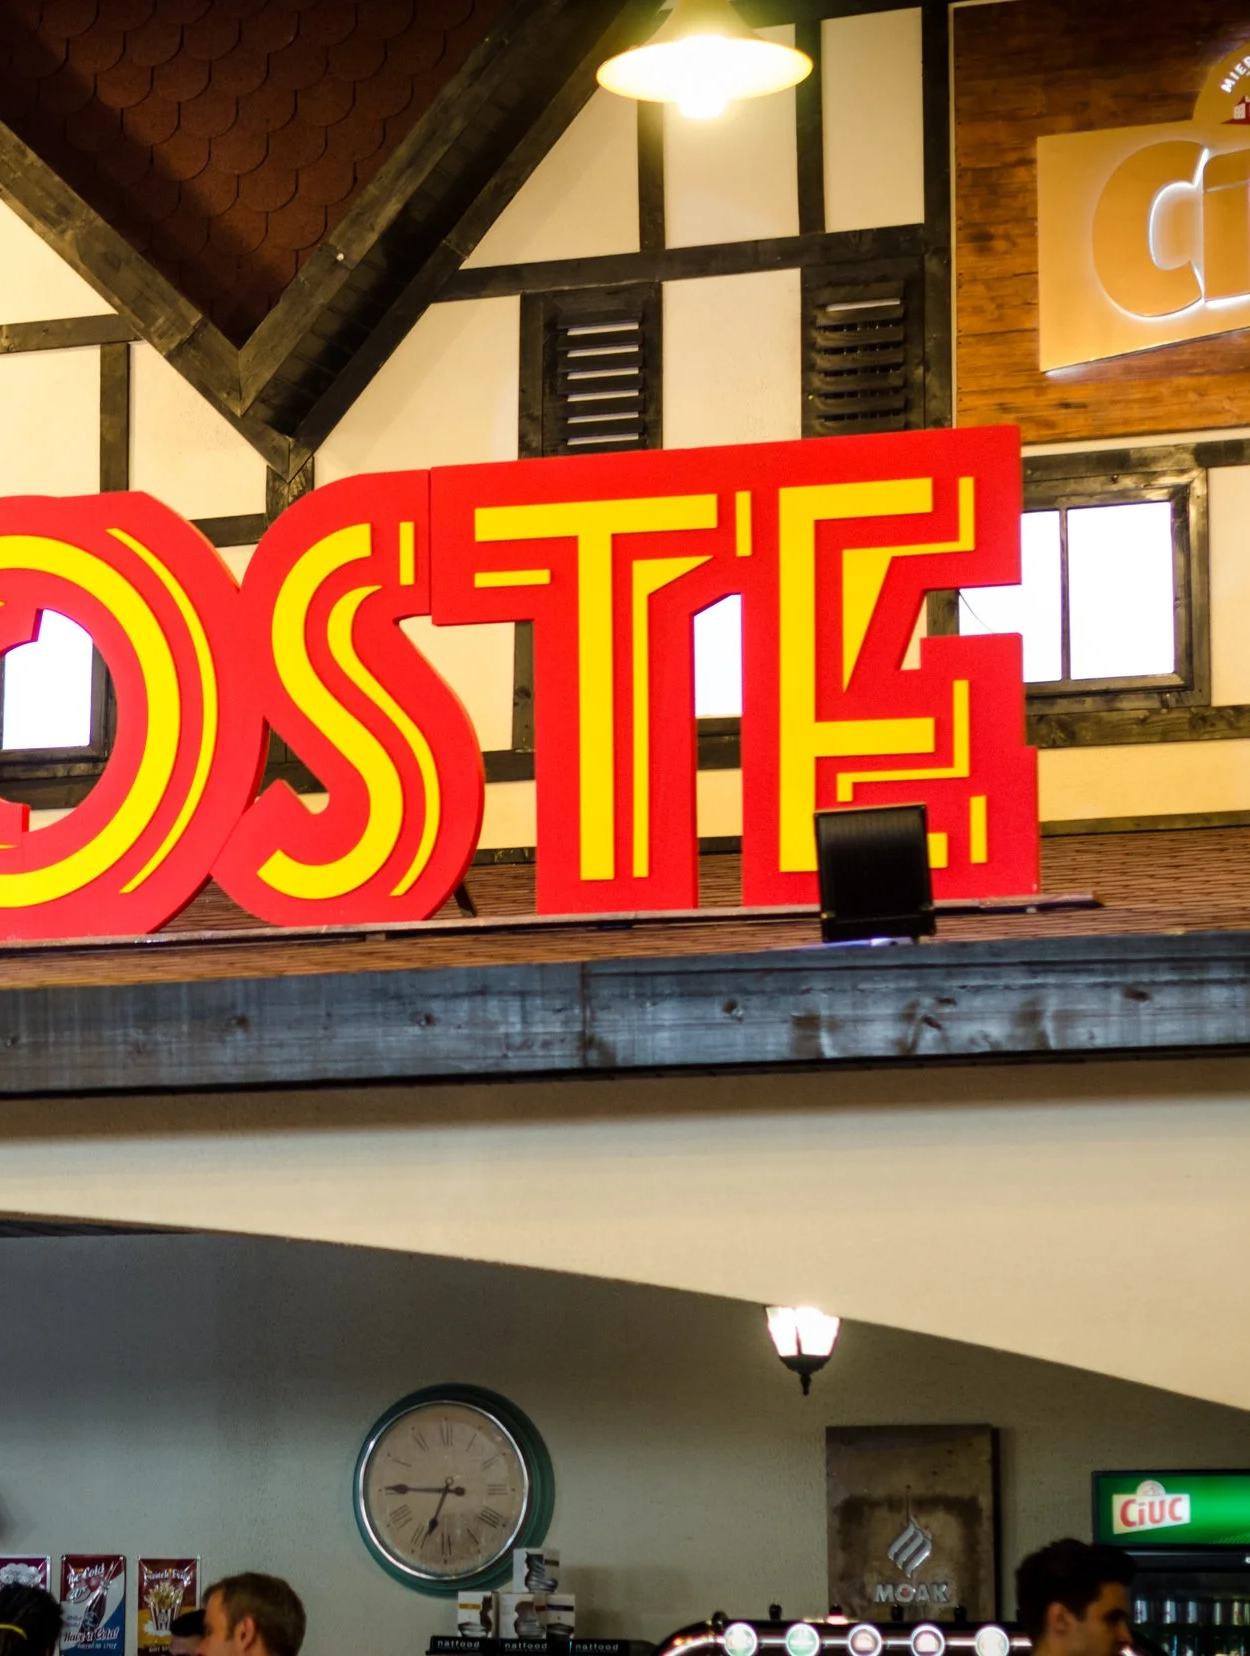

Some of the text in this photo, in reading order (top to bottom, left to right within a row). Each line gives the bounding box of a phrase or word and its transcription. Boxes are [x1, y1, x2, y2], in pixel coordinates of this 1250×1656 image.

[874, 1583, 949, 1603] MOAK
[437, 1639, 480, 1649] natfood
[504, 1641, 548, 1650] natfood
[575, 1643, 619, 1651] natfood
